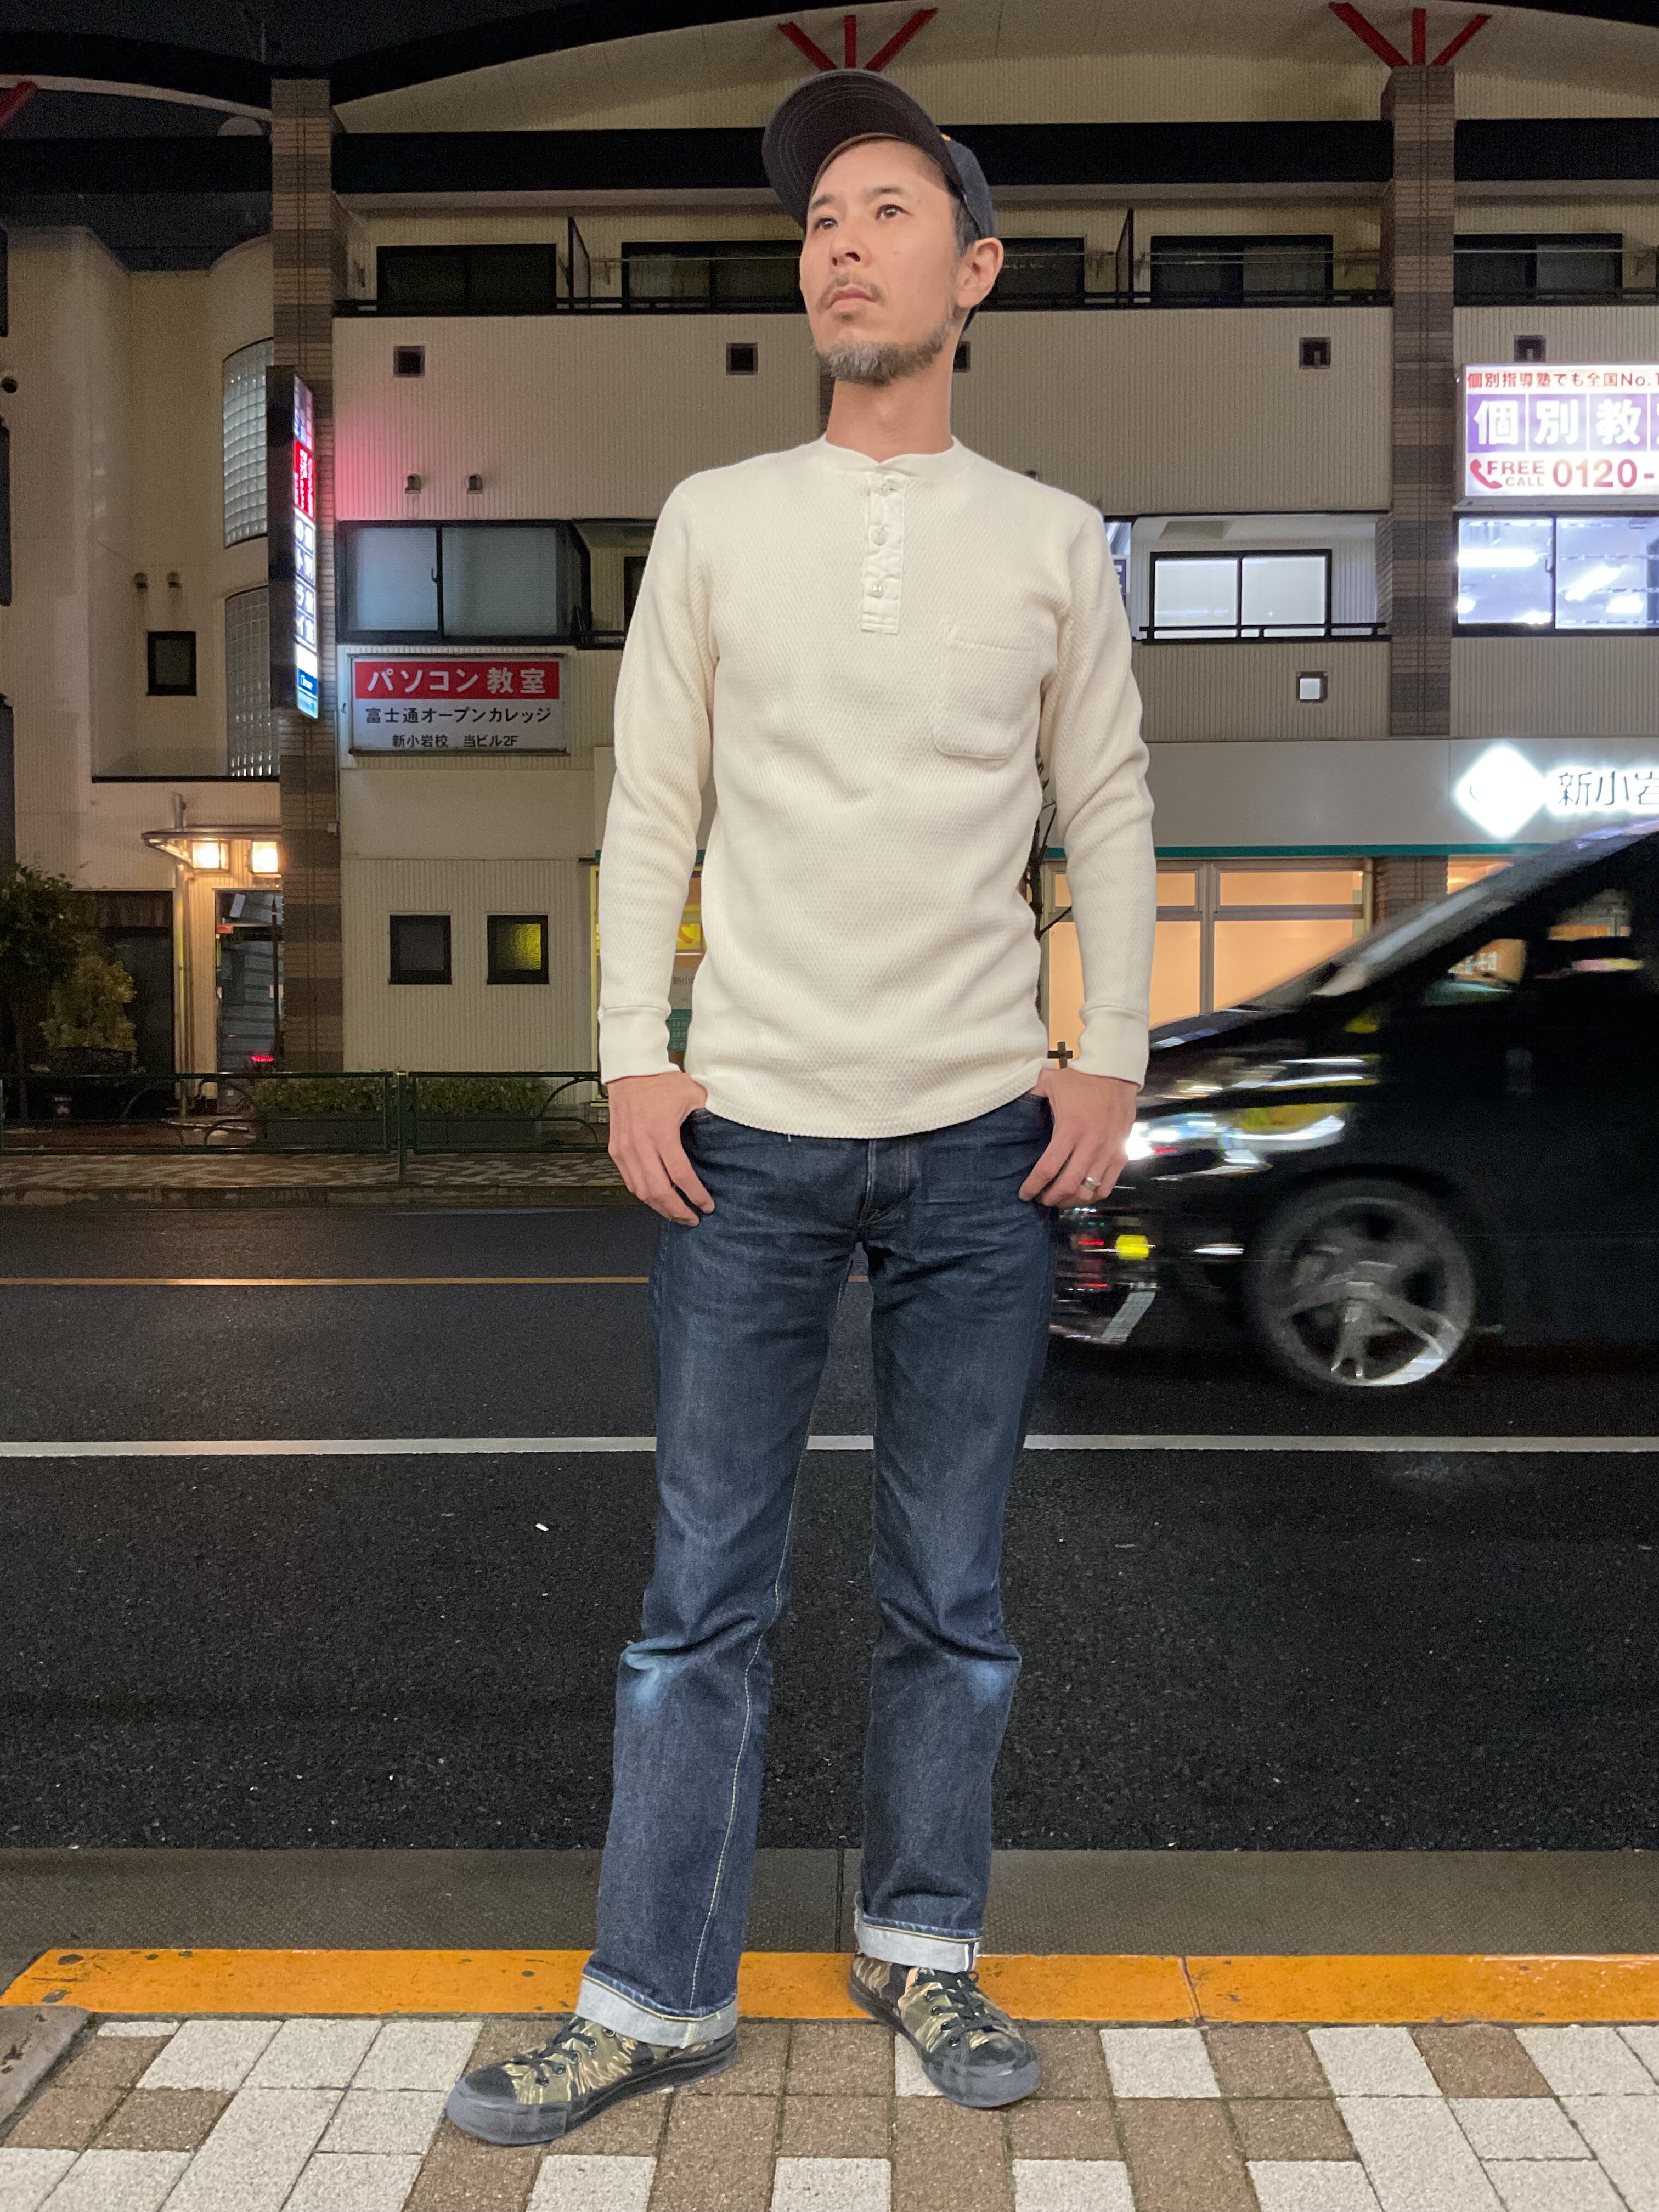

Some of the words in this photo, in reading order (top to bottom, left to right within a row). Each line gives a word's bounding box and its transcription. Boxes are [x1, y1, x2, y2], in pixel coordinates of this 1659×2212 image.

[1474, 399, 1659, 445] 個別教
[1487, 460, 1545, 475] FREE
[1505, 476, 1545, 487] CALL
[367, 668, 546, 694] パソコン教室
[366, 707, 551, 724] 富士通オープンカレッジ
[392, 735, 449, 748] 新小岩校
[464, 734, 519, 748] 当ビル2F
